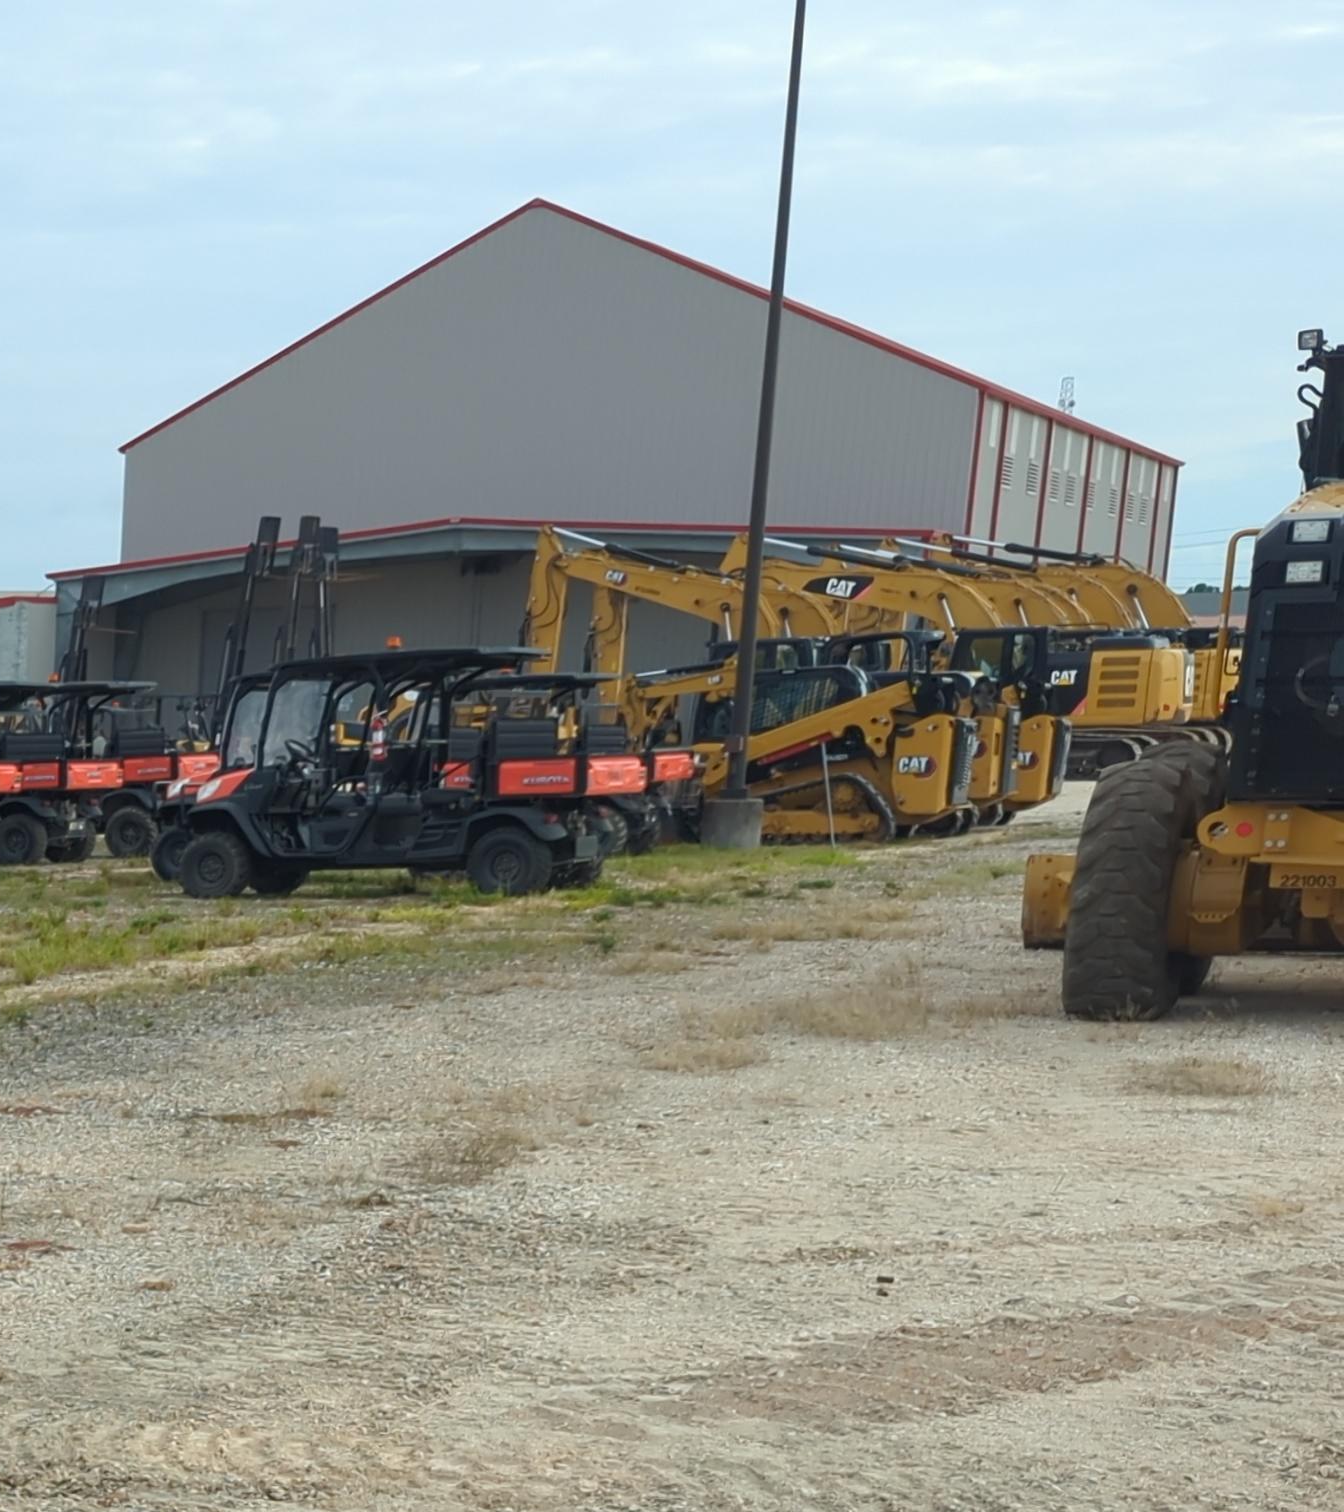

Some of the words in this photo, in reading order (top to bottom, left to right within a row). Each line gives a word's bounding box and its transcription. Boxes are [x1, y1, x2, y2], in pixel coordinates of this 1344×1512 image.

[825, 577, 857, 598] CAT
[1050, 669, 1078, 685] CAT
[898, 756, 929, 773] CAT
[1016, 751, 1032, 766] AT
[1279, 874, 1336, 888] 221003
